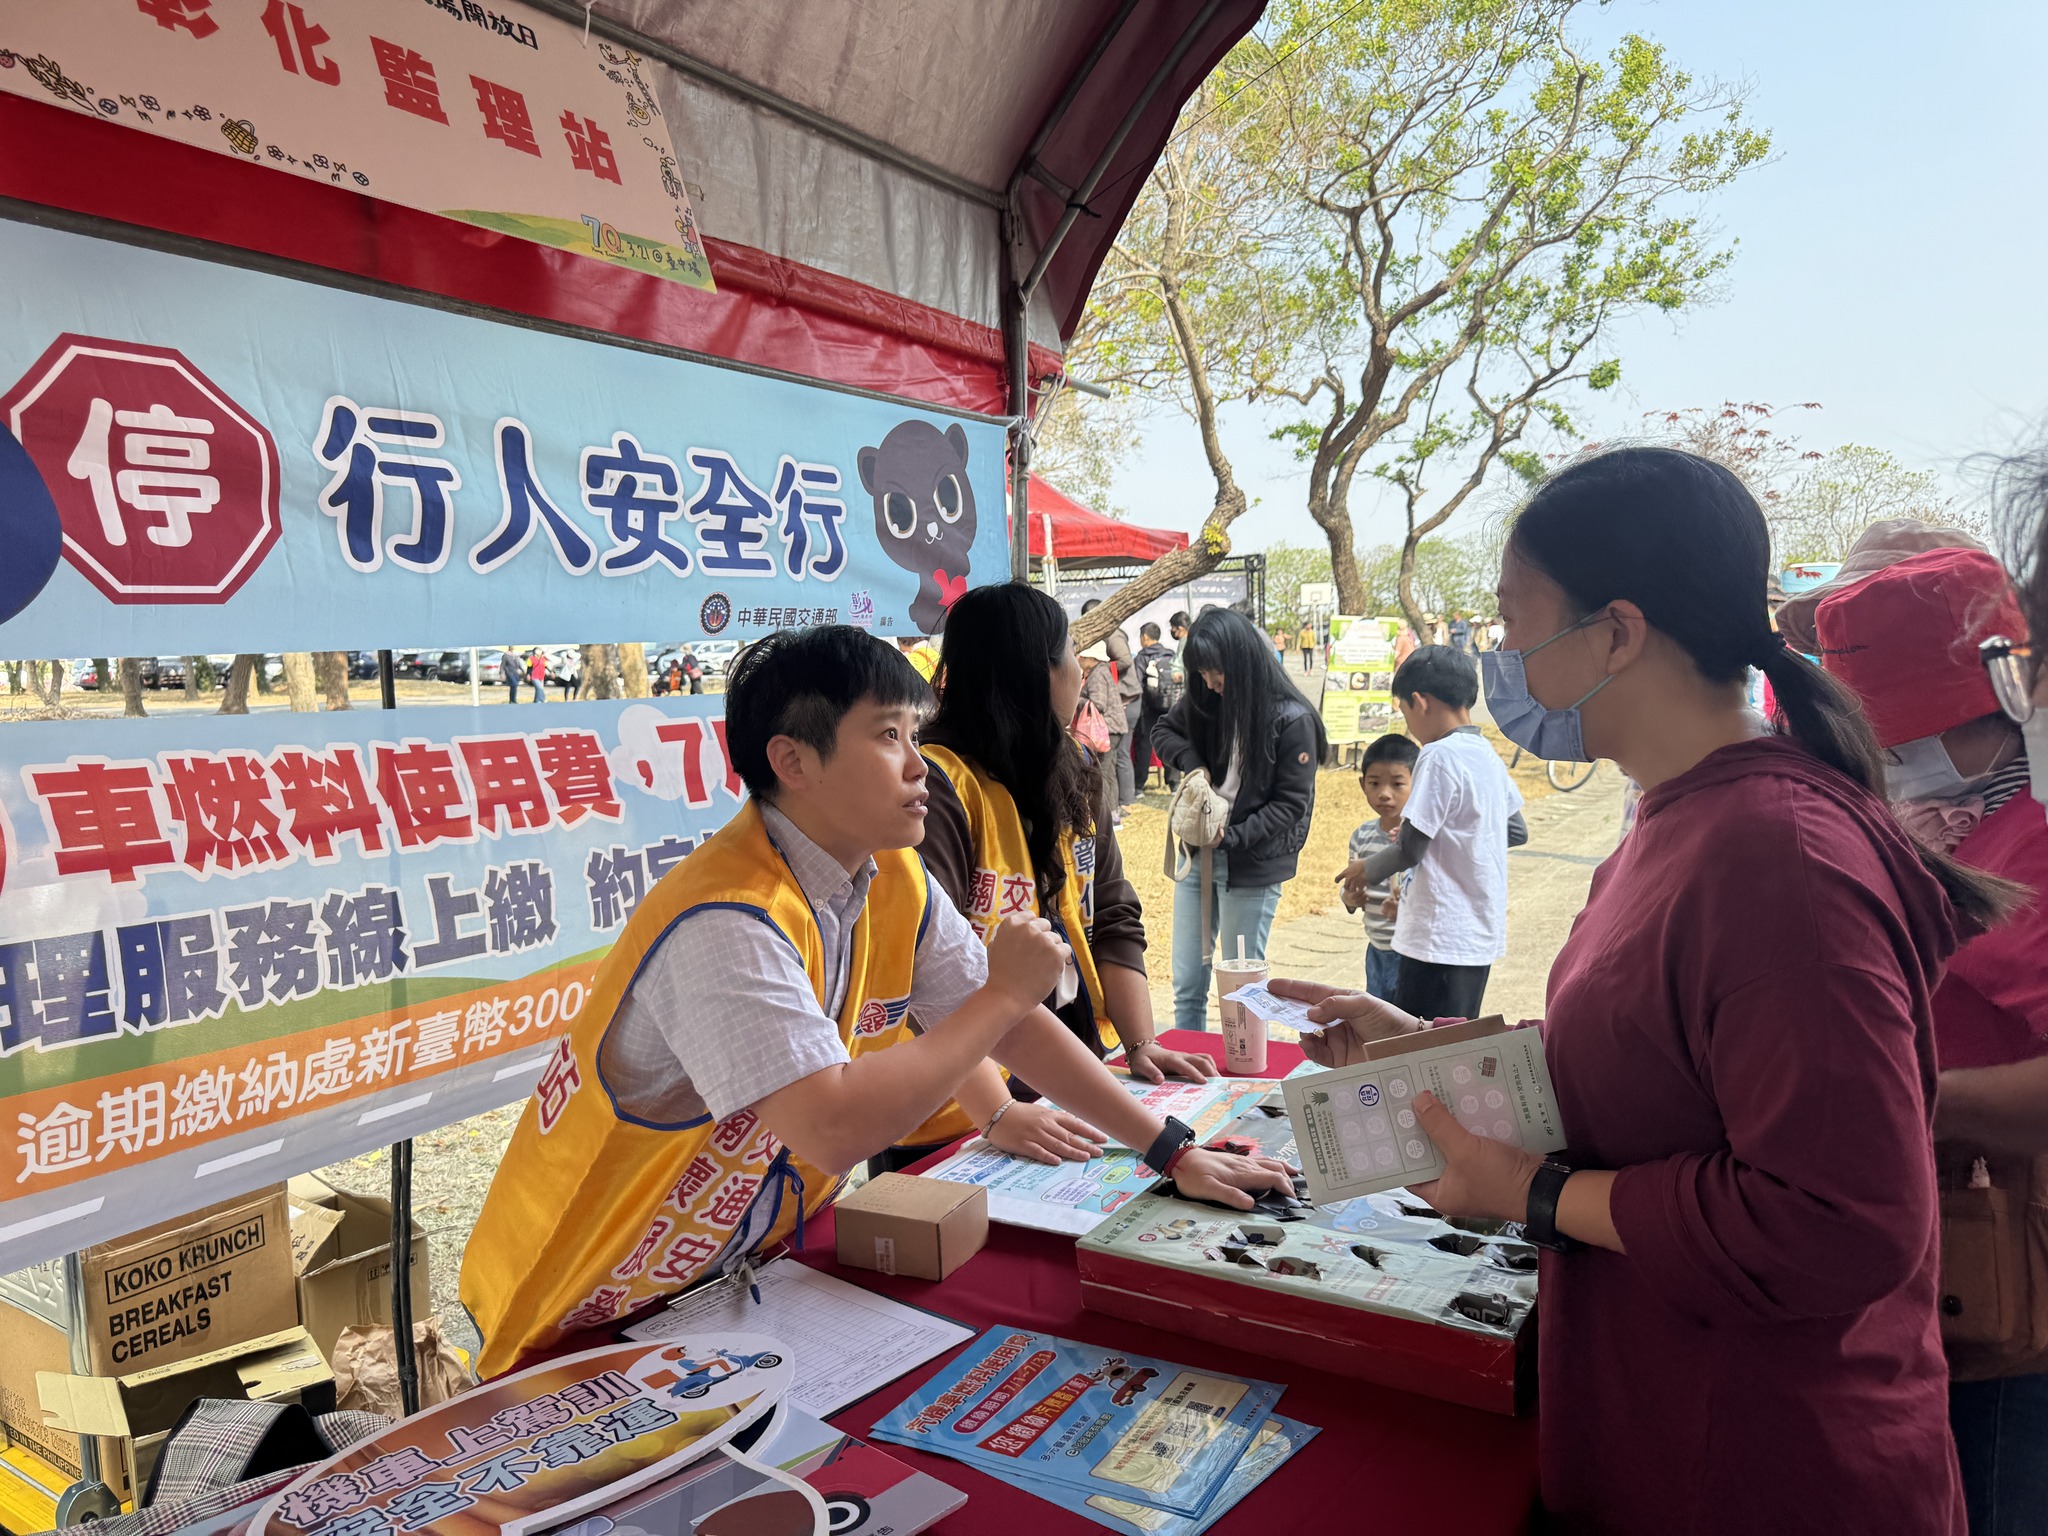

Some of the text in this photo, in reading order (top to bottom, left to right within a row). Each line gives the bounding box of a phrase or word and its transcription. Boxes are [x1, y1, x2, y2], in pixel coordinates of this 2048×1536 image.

[424, 0, 538, 50] 場開放日
[67, 398, 220, 547] 停
[314, 396, 847, 581] 行人安全行
[737, 607, 838, 628] 中華民國交通部
[879, 616, 894, 627] 廣告
[16, 985, 596, 1185] 逾期繳納處新臺幣300
[113, 1256, 173, 1297] KOKO
[179, 1222, 261, 1273] KRUNCH
[109, 1271, 232, 1338] BREAKFAST
[111, 1307, 211, 1364] CEREALS
[904, 1333, 1037, 1434] 汽機車燃料使用費
[29, 1439, 42, 1455] THE
[43, 1447, 82, 1480] PHILIPPINE
[277, 1370, 643, 1525] 機車上駕訓
